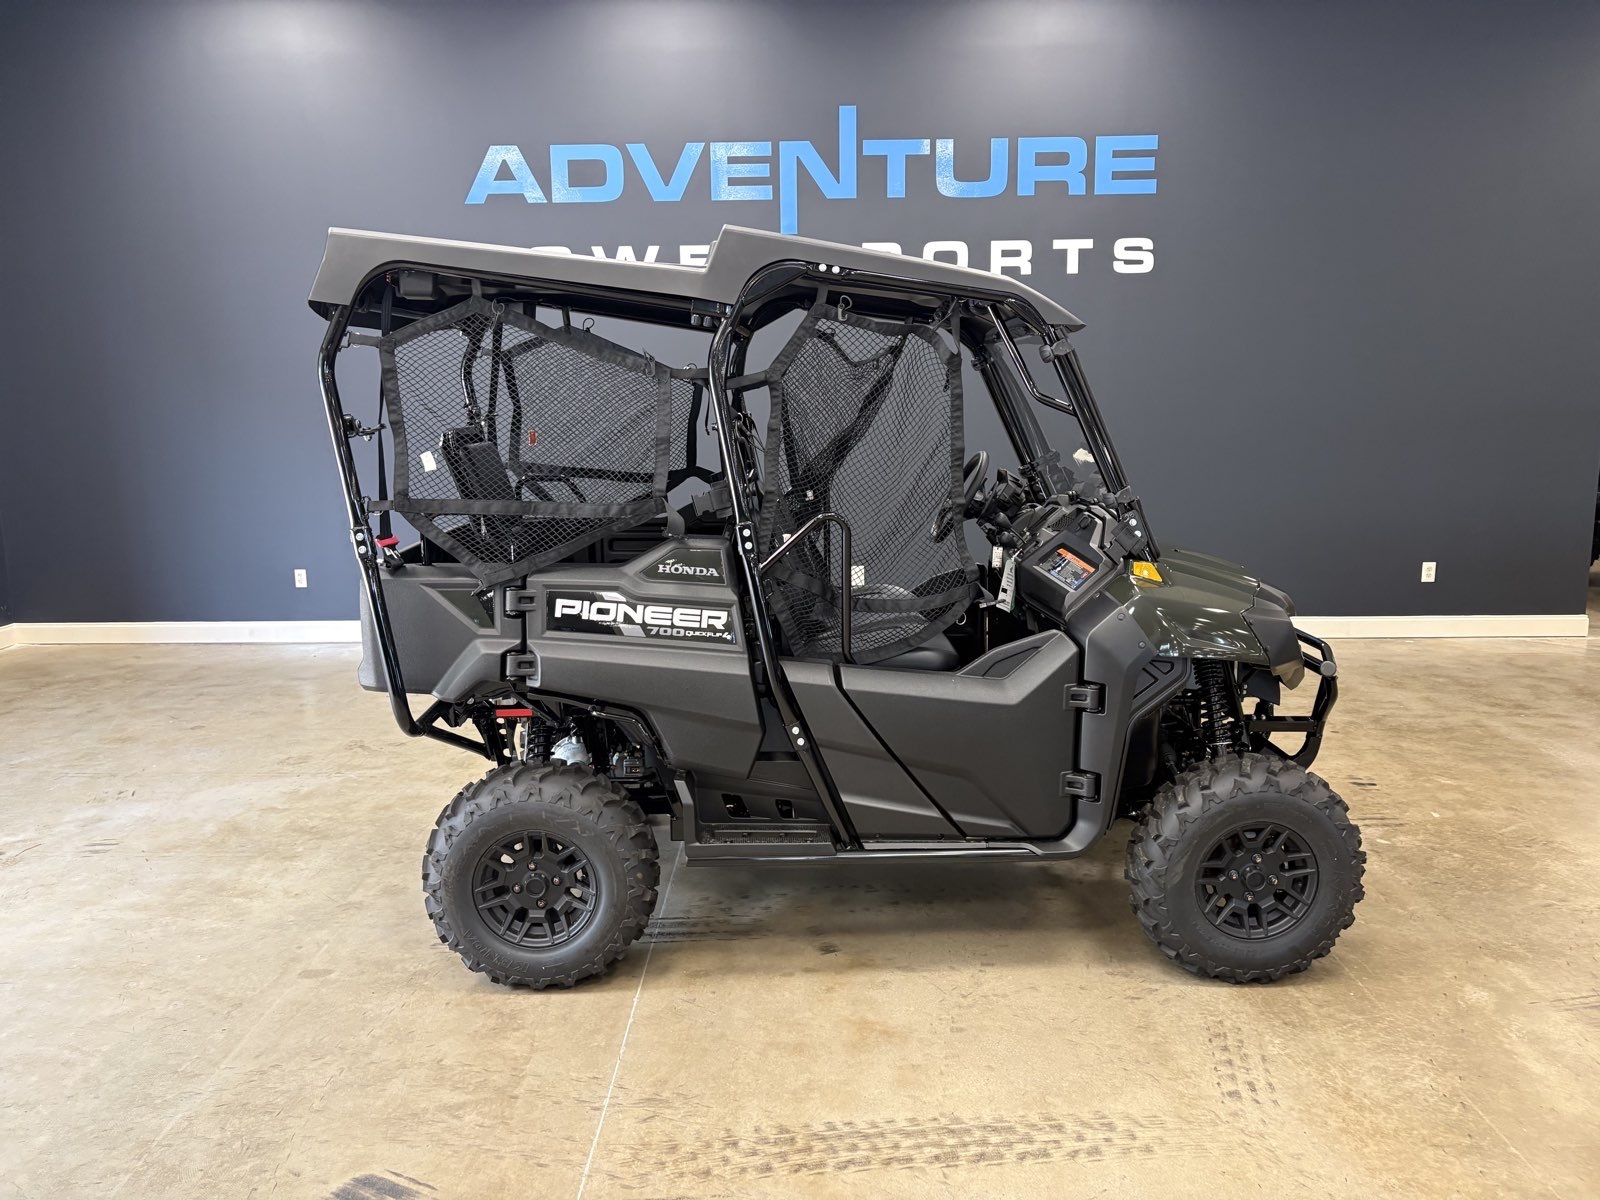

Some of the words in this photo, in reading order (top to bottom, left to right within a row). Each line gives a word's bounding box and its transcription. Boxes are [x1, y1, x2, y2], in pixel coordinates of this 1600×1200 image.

[464, 105, 1159, 235] ADVENTURE
[657, 563, 720, 577] HONDA
[554, 598, 728, 630] PIONEER
[647, 626, 685, 637] 700
